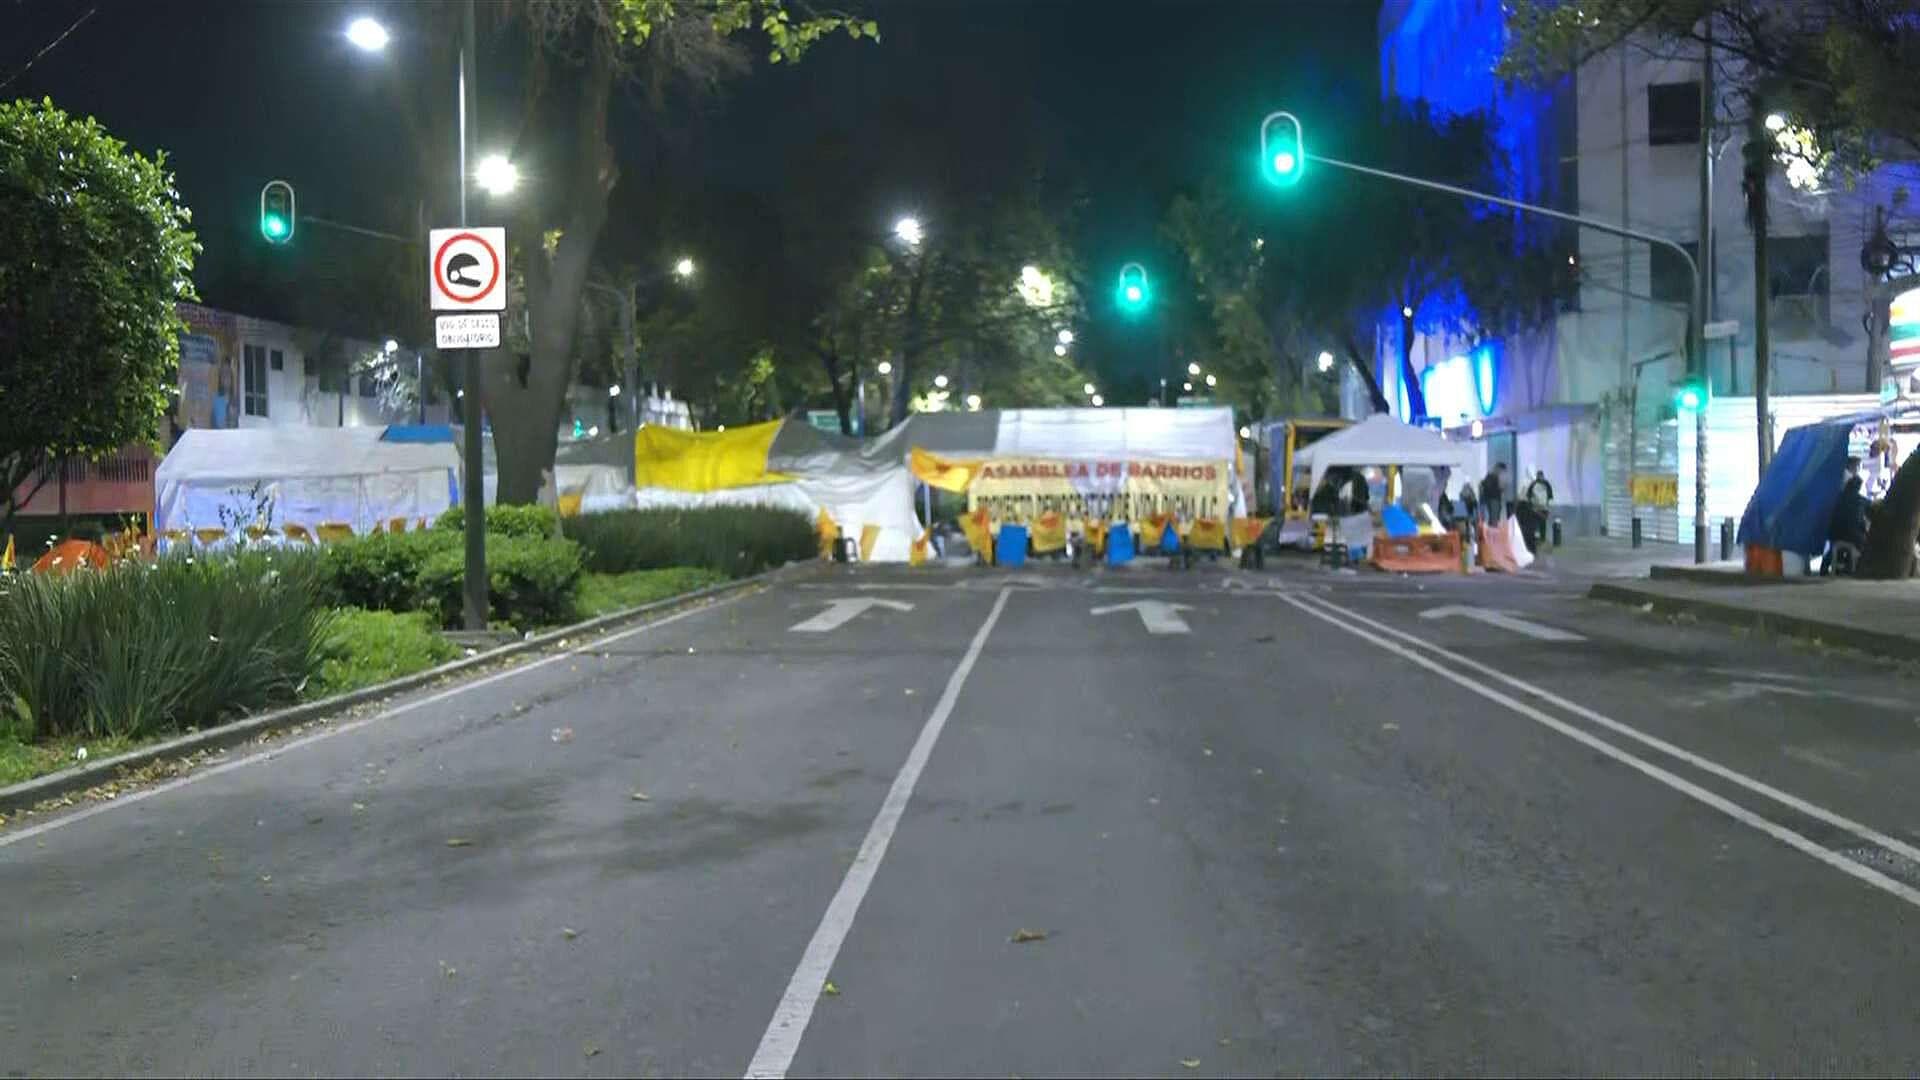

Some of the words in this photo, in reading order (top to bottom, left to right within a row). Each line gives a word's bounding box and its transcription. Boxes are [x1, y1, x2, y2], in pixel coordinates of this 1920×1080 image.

[982, 463, 1089, 478] ASAMBLEA
[1096, 462, 1122, 477] DE
[1128, 462, 1217, 480] BARRIOS
